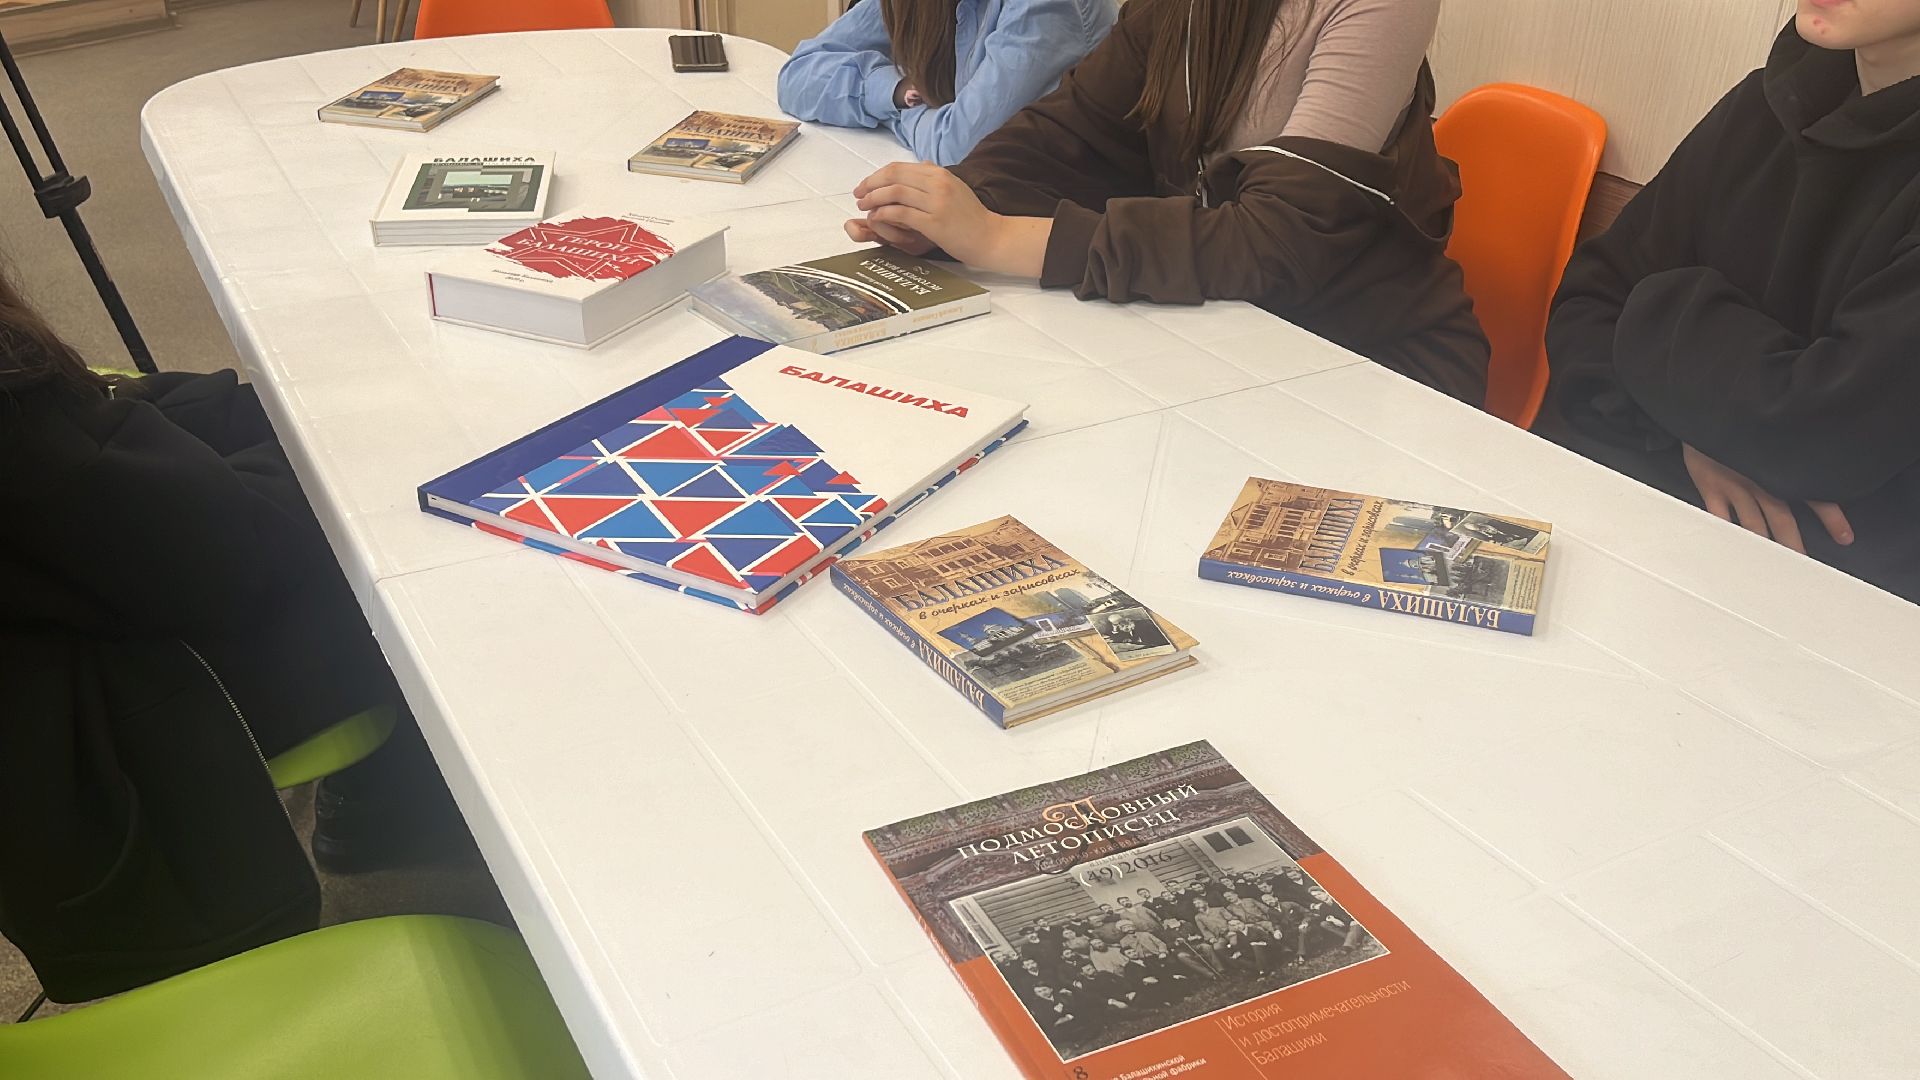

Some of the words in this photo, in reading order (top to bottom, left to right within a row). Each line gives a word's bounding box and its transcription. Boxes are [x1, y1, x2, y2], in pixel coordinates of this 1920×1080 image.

[517, 239, 641, 266] БАЛАШИХИ
[557, 235, 632, 253] ГЕРОИ
[859, 260, 931, 296] БАЛАШИХА
[778, 365, 969, 418] БАЛАШИХА
[1299, 498, 1366, 574] БАЛАШИХА
[1361, 500, 1385, 538] зарисовках
[1341, 568, 1355, 576] в
[1347, 543, 1367, 572] очерках
[843, 582, 879, 616] зарисовках
[891, 554, 1069, 612] БАЛАШИХА
[919, 610, 927, 620] в
[931, 596, 988, 617] очерках
[990, 593, 1001, 601] и
[1003, 568, 1080, 598] зарисовках
[1227, 570, 1297, 594] зарисовках
[1299, 581, 1309, 590] и
[1311, 584, 1361, 602] очерках
[1362, 592, 1371, 604] в
[1377, 588, 1501, 629] БАЛАШИХА
[885, 617, 911, 643] очерках
[919, 638, 985, 711] БАЛАШИХА
[957, 783, 1200, 860] ПОДМОСКОВНЫЙ
[1012, 810, 1181, 865] ЛЕТОПИСЕЦ
[1221, 1003, 1283, 1031] История
[1238, 1036, 1252, 1048] и
[1252, 980, 1412, 1046] достопримечательности
[1251, 1032, 1329, 1066] Балашихи
[1169, 1057, 1207, 1077] фабрики
